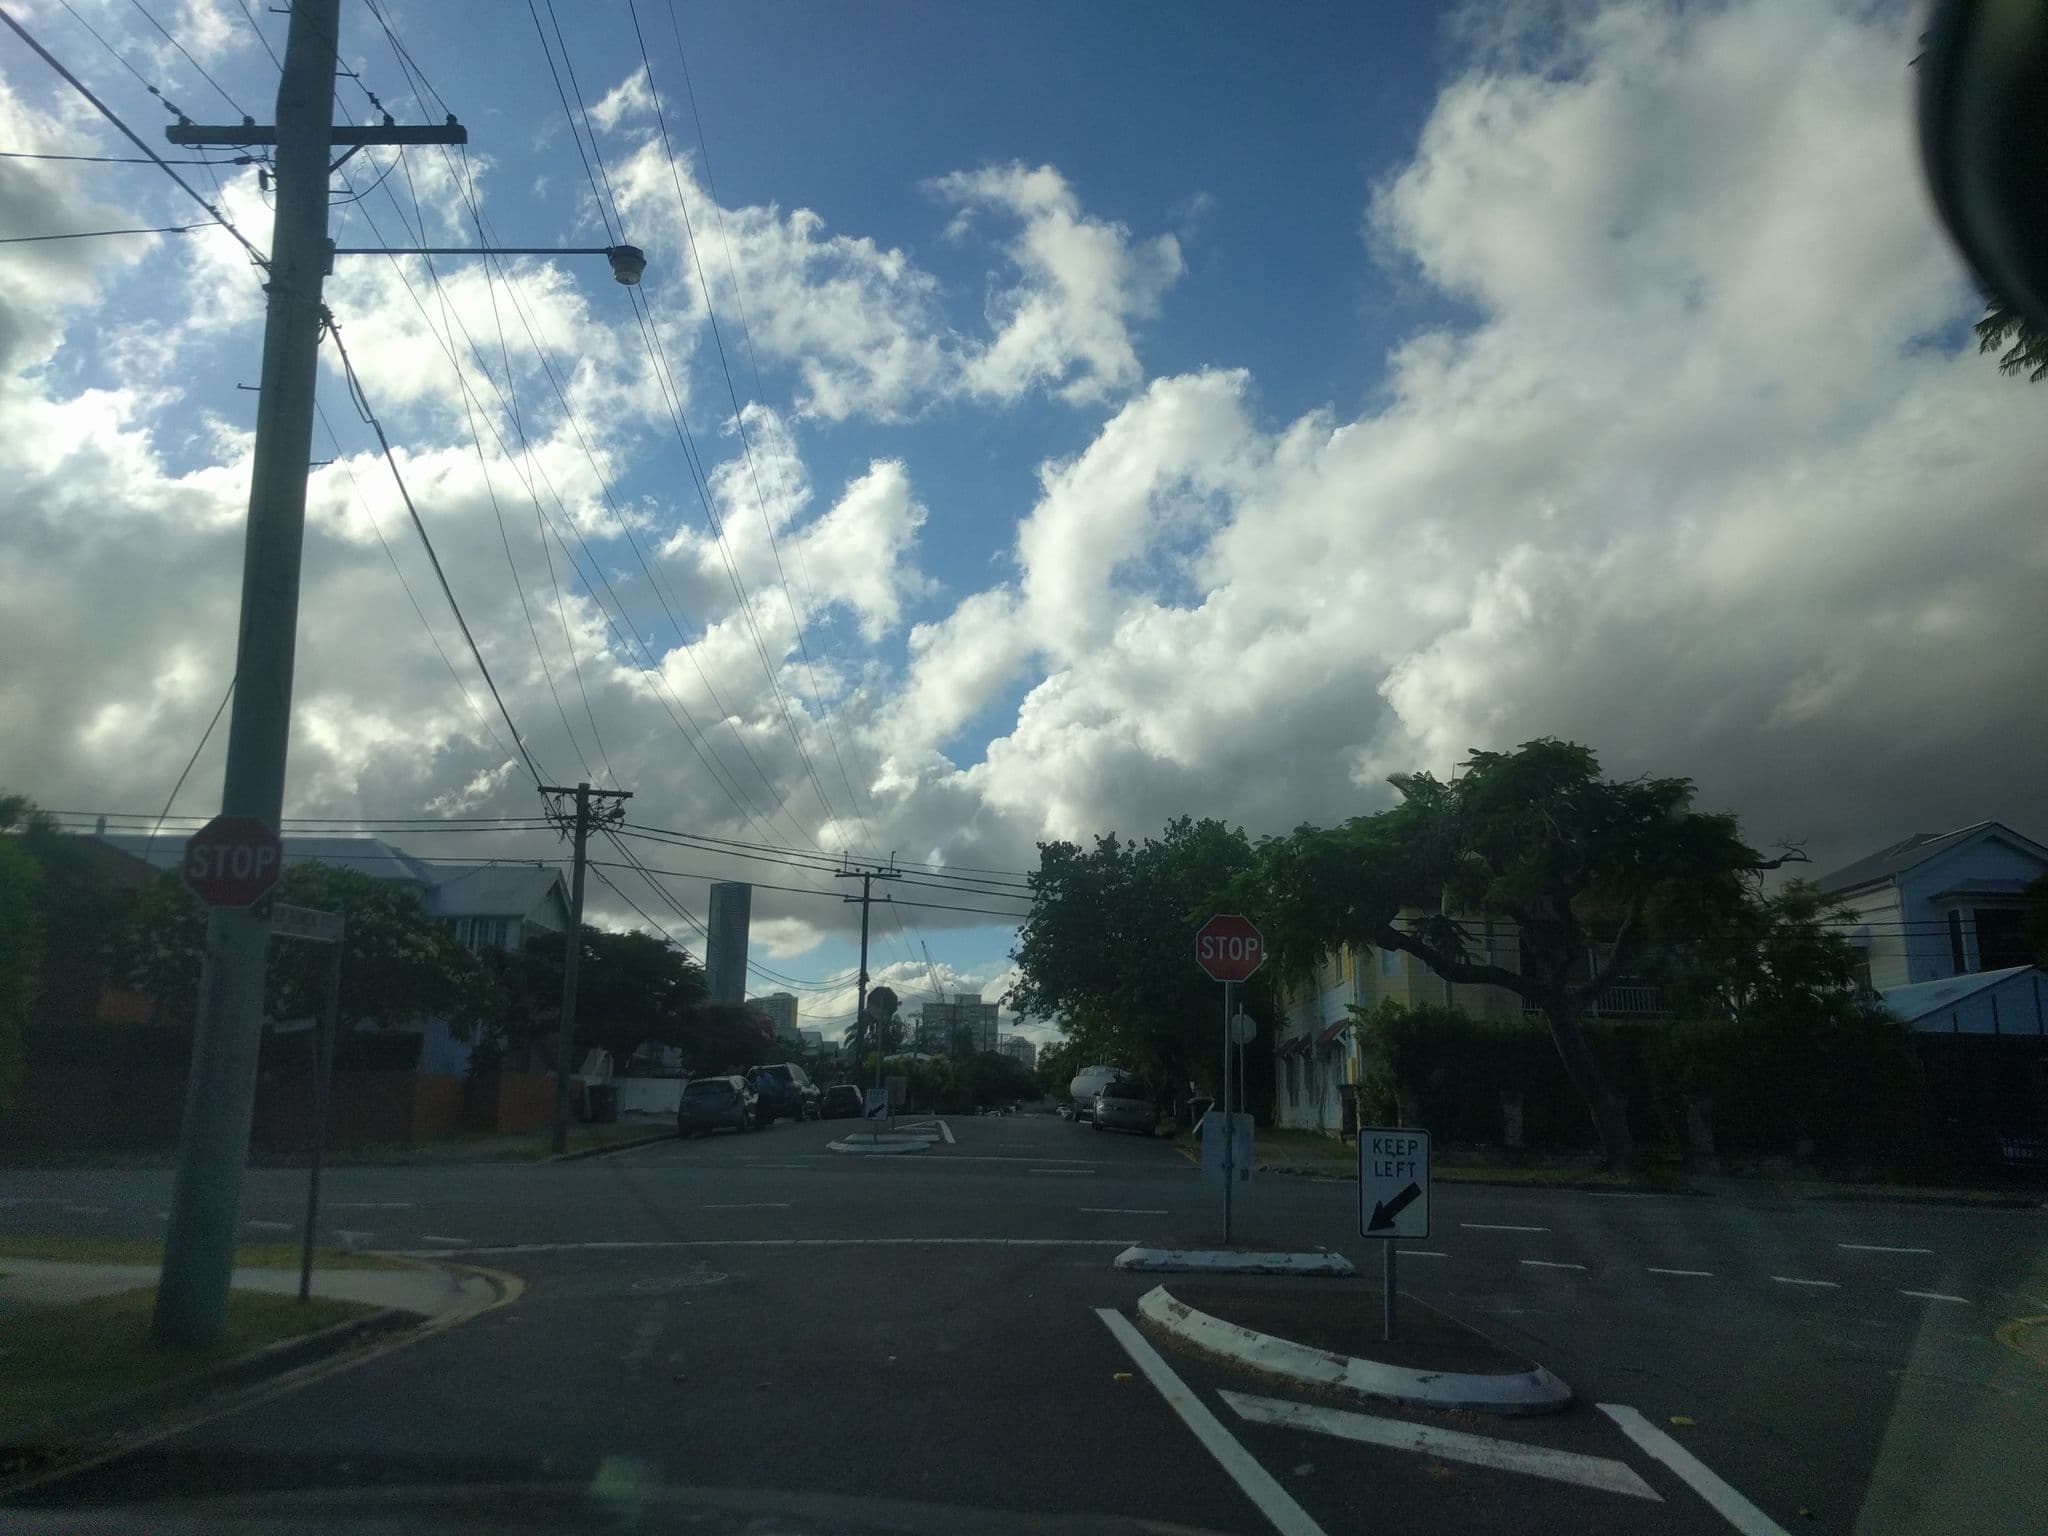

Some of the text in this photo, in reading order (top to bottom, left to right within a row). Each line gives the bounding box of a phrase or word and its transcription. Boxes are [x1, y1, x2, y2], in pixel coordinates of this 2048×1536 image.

[191, 845, 275, 879] STOP
[1201, 937, 1259, 961] STOP
[1373, 1139, 1418, 1156] KEEP
[1375, 1161, 1416, 1177] LEFT
